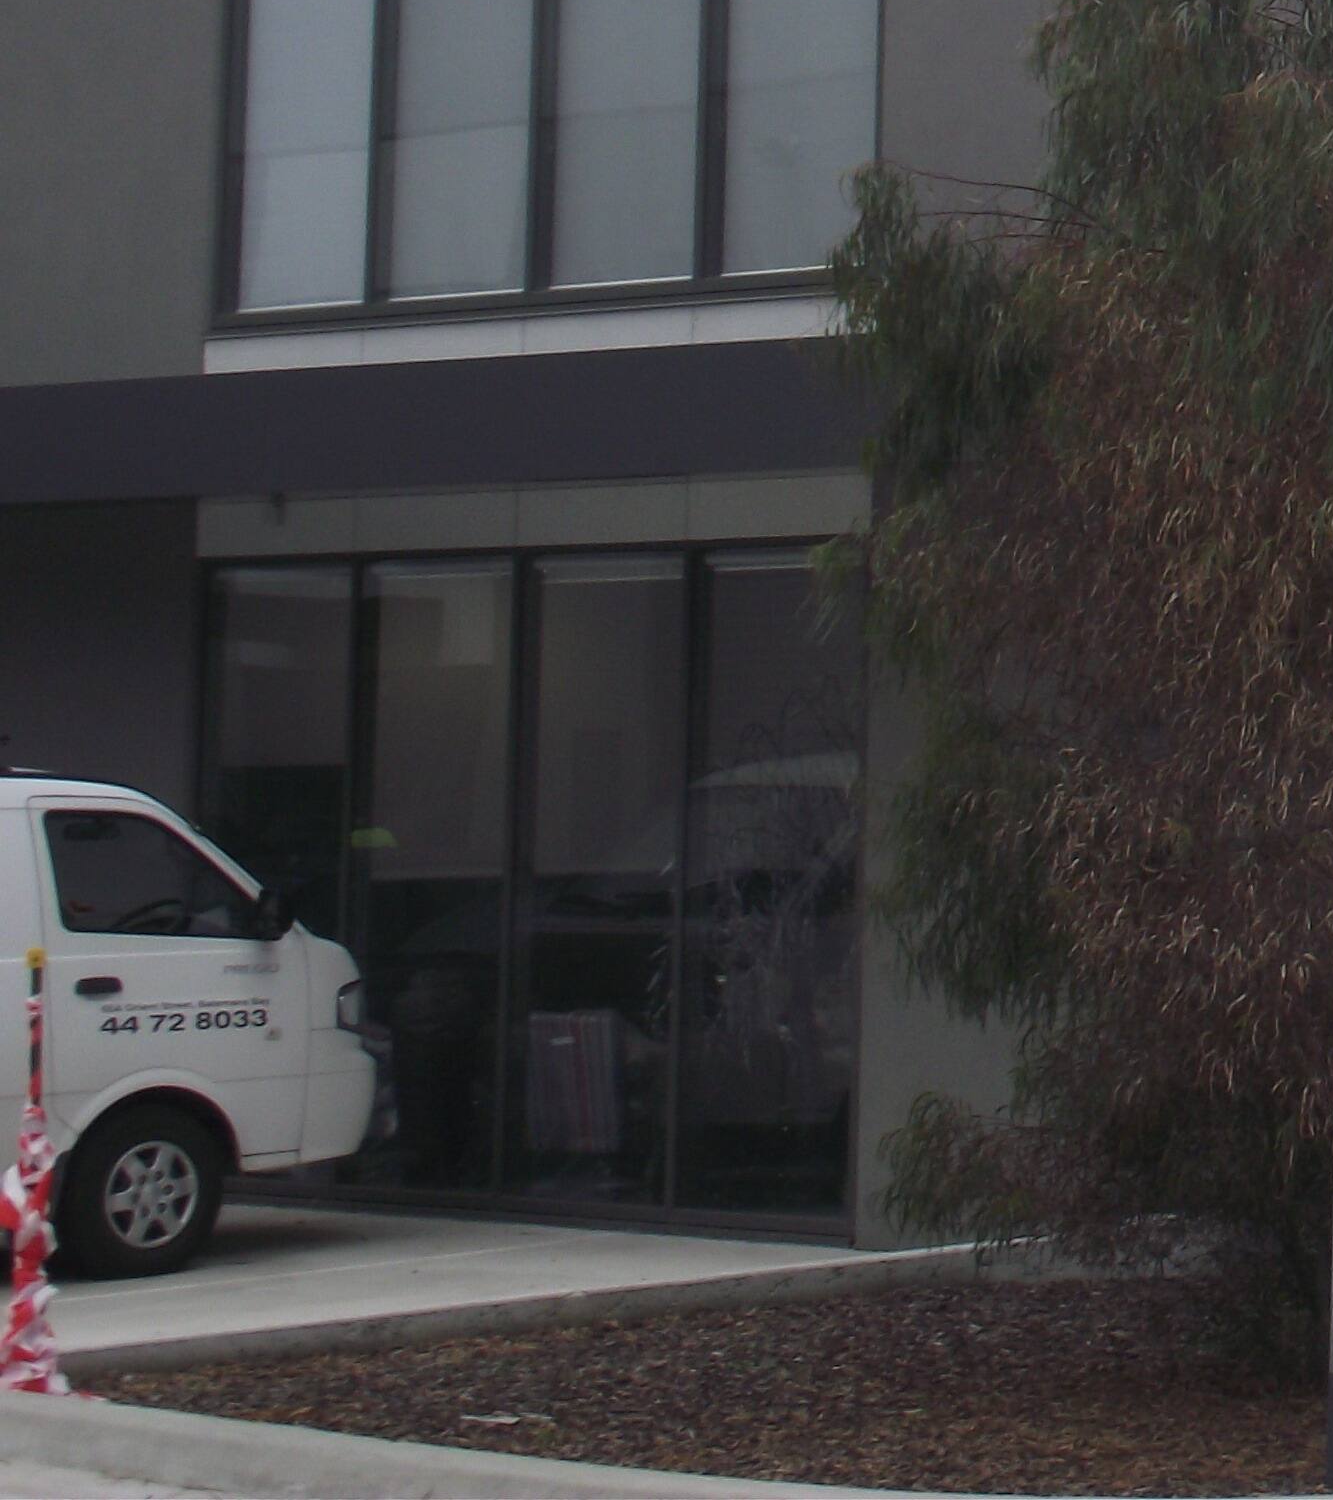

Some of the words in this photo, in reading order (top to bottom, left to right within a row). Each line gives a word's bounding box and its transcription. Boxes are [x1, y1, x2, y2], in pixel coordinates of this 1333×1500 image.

[100, 1016, 139, 1034] 44
[149, 1013, 186, 1032] 72
[195, 1010, 268, 1030] 8033
